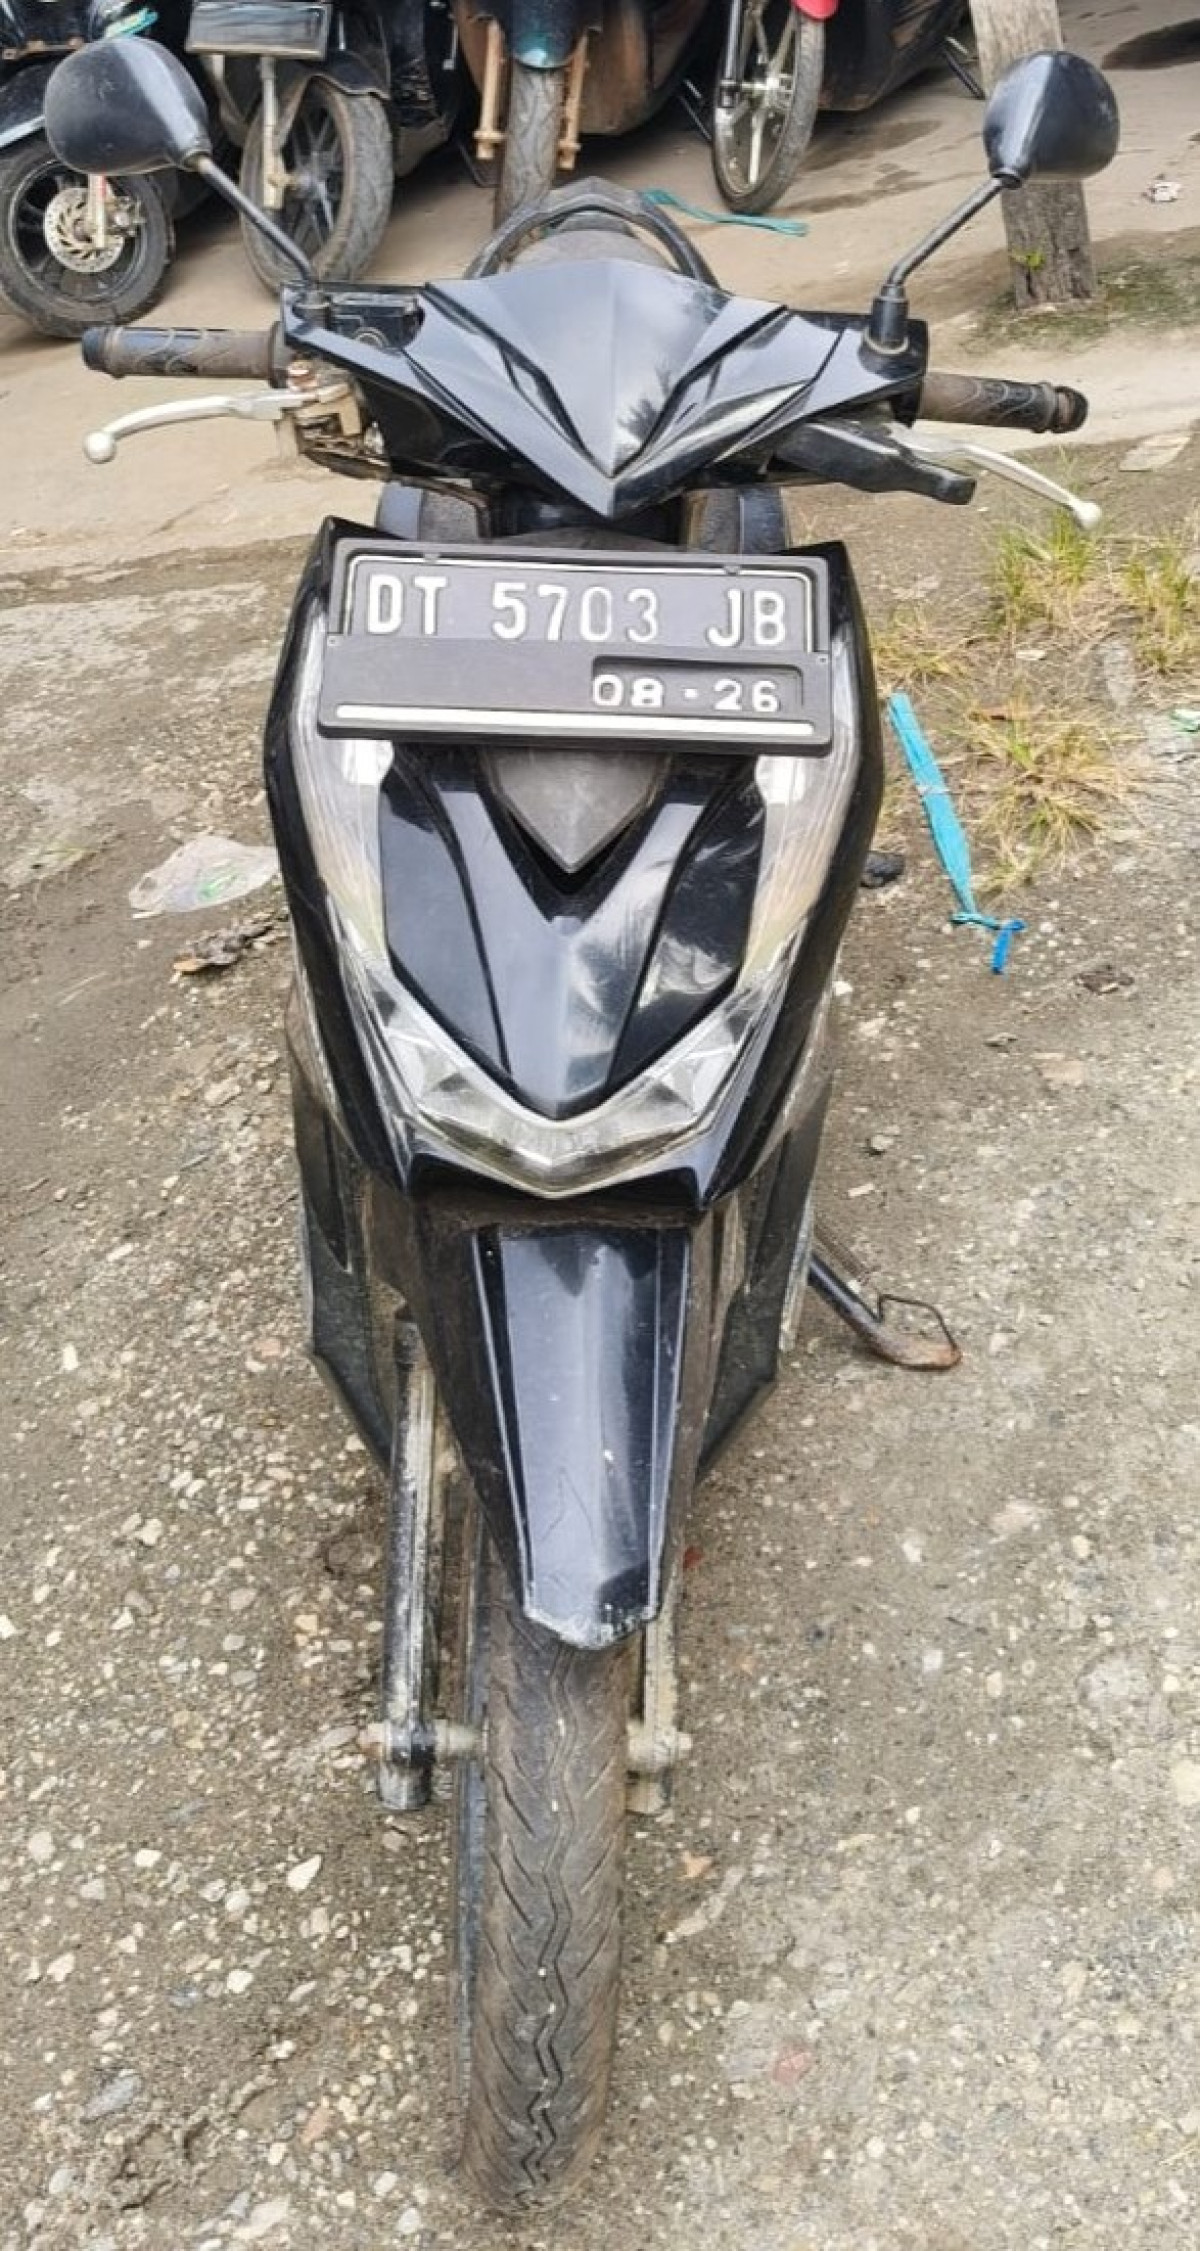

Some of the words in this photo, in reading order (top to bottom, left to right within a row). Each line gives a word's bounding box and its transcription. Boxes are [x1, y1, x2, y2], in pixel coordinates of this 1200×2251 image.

[367, 573, 447, 635] DT
[491, 582, 660, 643] 5703
[706, 588, 787, 647] JB
